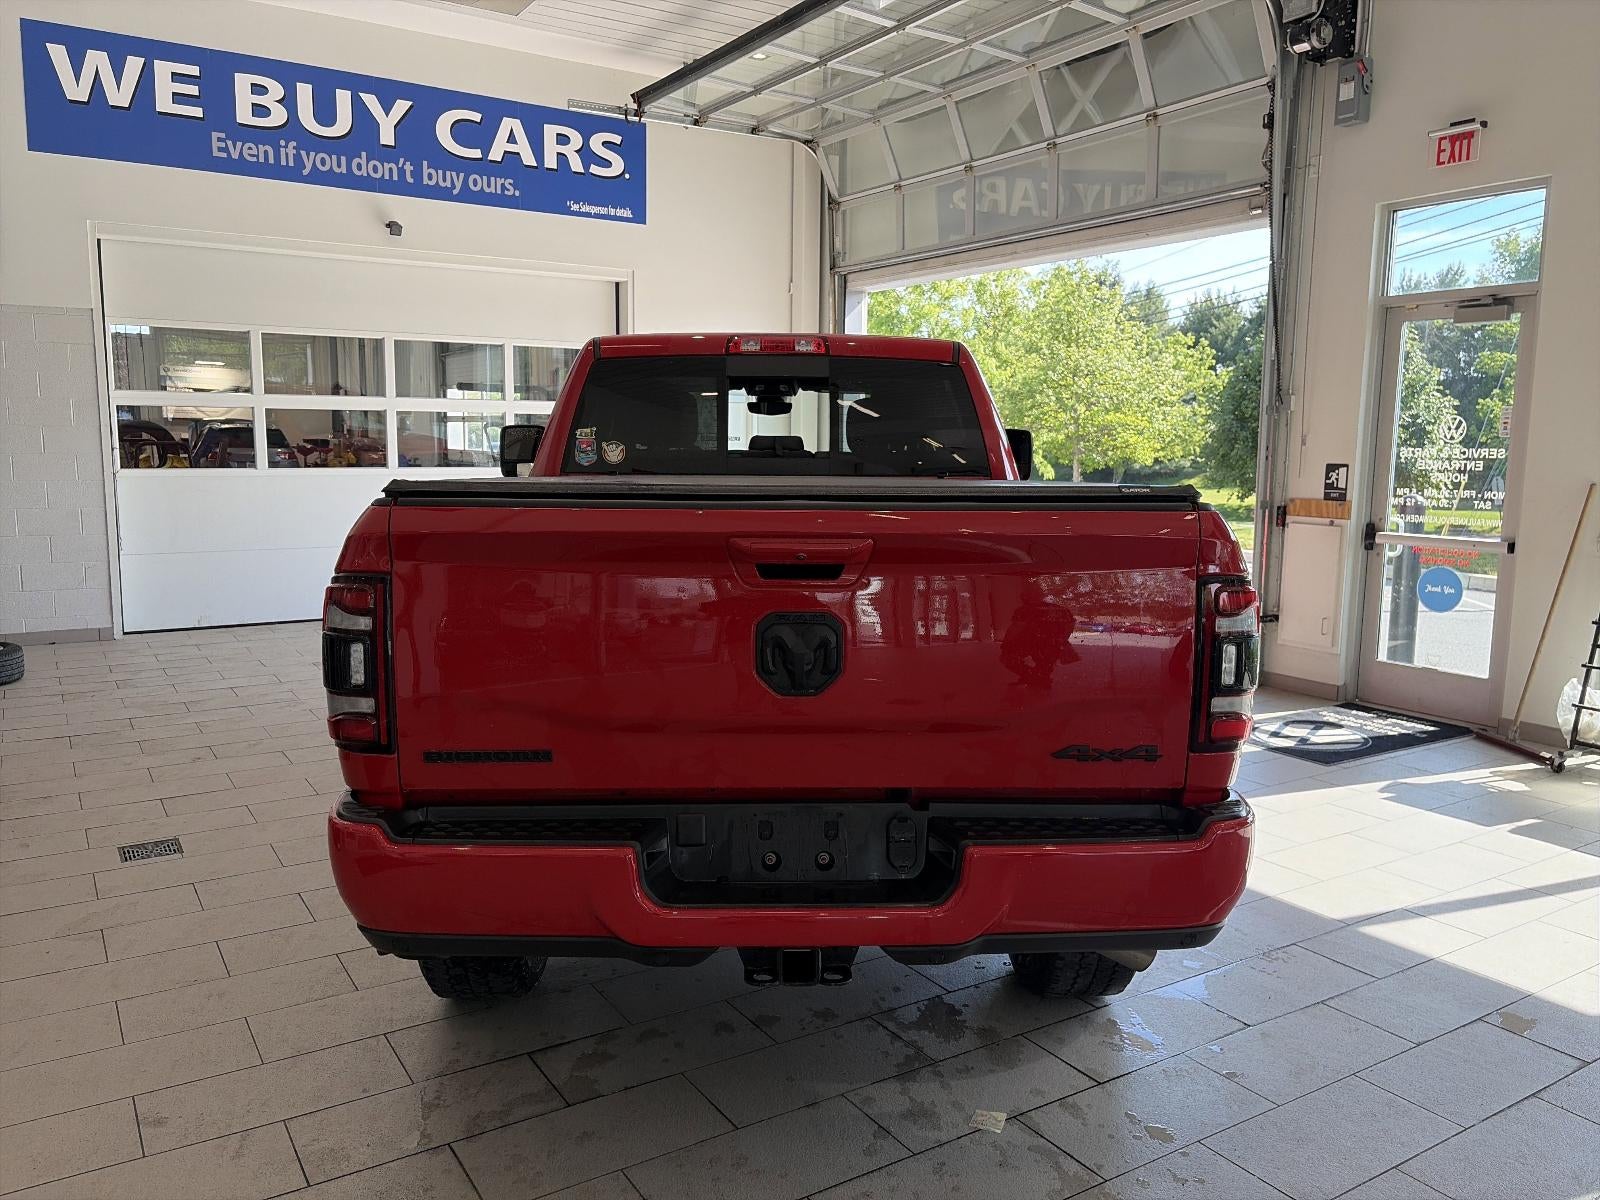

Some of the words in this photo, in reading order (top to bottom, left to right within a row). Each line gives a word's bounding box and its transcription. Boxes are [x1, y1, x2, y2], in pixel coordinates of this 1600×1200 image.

[45, 42, 204, 119] WE
[234, 72, 413, 148] BUY
[435, 107, 631, 180] CARS.
[211, 131, 275, 164] Even
[279, 139, 296, 167] if
[300, 149, 347, 176] you
[351, 151, 414, 184] don't
[422, 160, 465, 195] buy
[468, 172, 520, 197] ours.
[1436, 130, 1475, 166] EXIT
